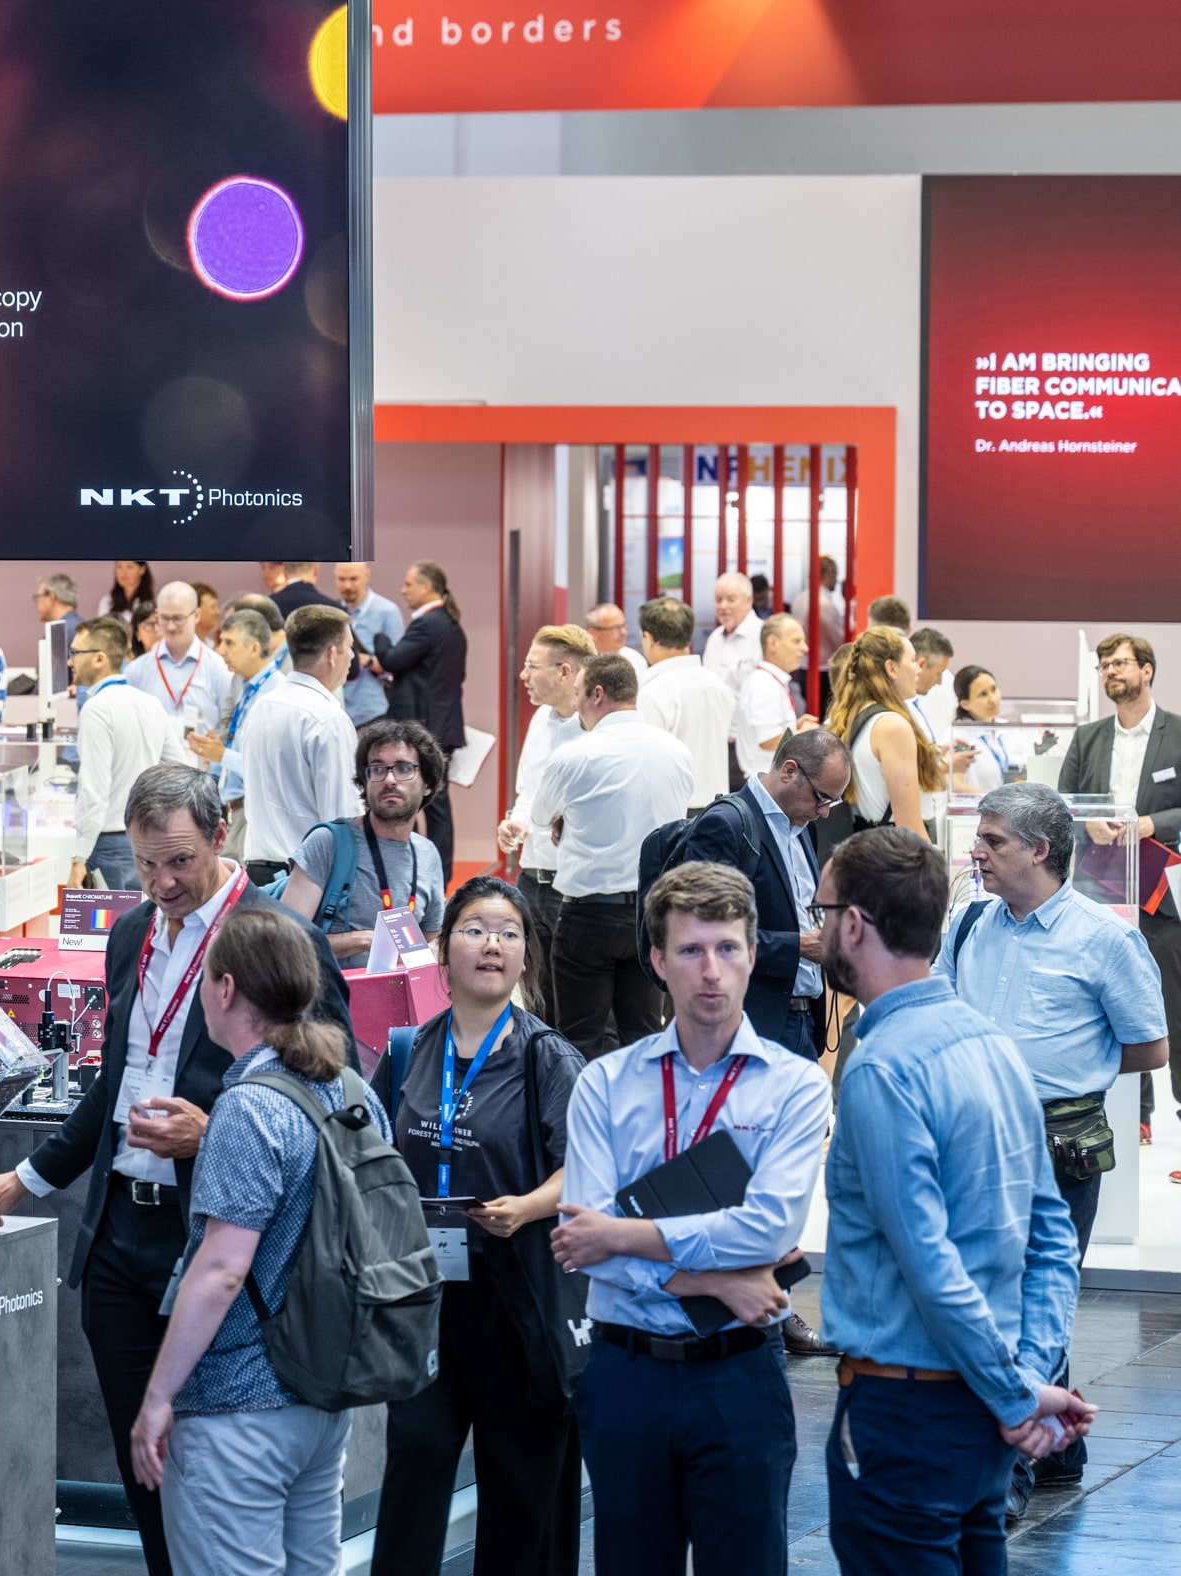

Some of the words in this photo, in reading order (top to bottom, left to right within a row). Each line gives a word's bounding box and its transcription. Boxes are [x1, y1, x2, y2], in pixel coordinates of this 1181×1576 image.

[441, 13, 622, 46] borders
[1001, 352, 1037, 372] AM
[1041, 353, 1151, 372] BRINGING
[975, 376, 1040, 396] FIBER
[974, 400, 1007, 419] TO
[975, 438, 996, 453] Dr.
[998, 438, 1056, 453] Andreas
[1058, 439, 1137, 454] Hornsteiner
[80, 488, 190, 506] NKT
[208, 488, 303, 506] Photonics
[62, 937, 83, 946] New!
[407, 1128, 433, 1138] FOREST
